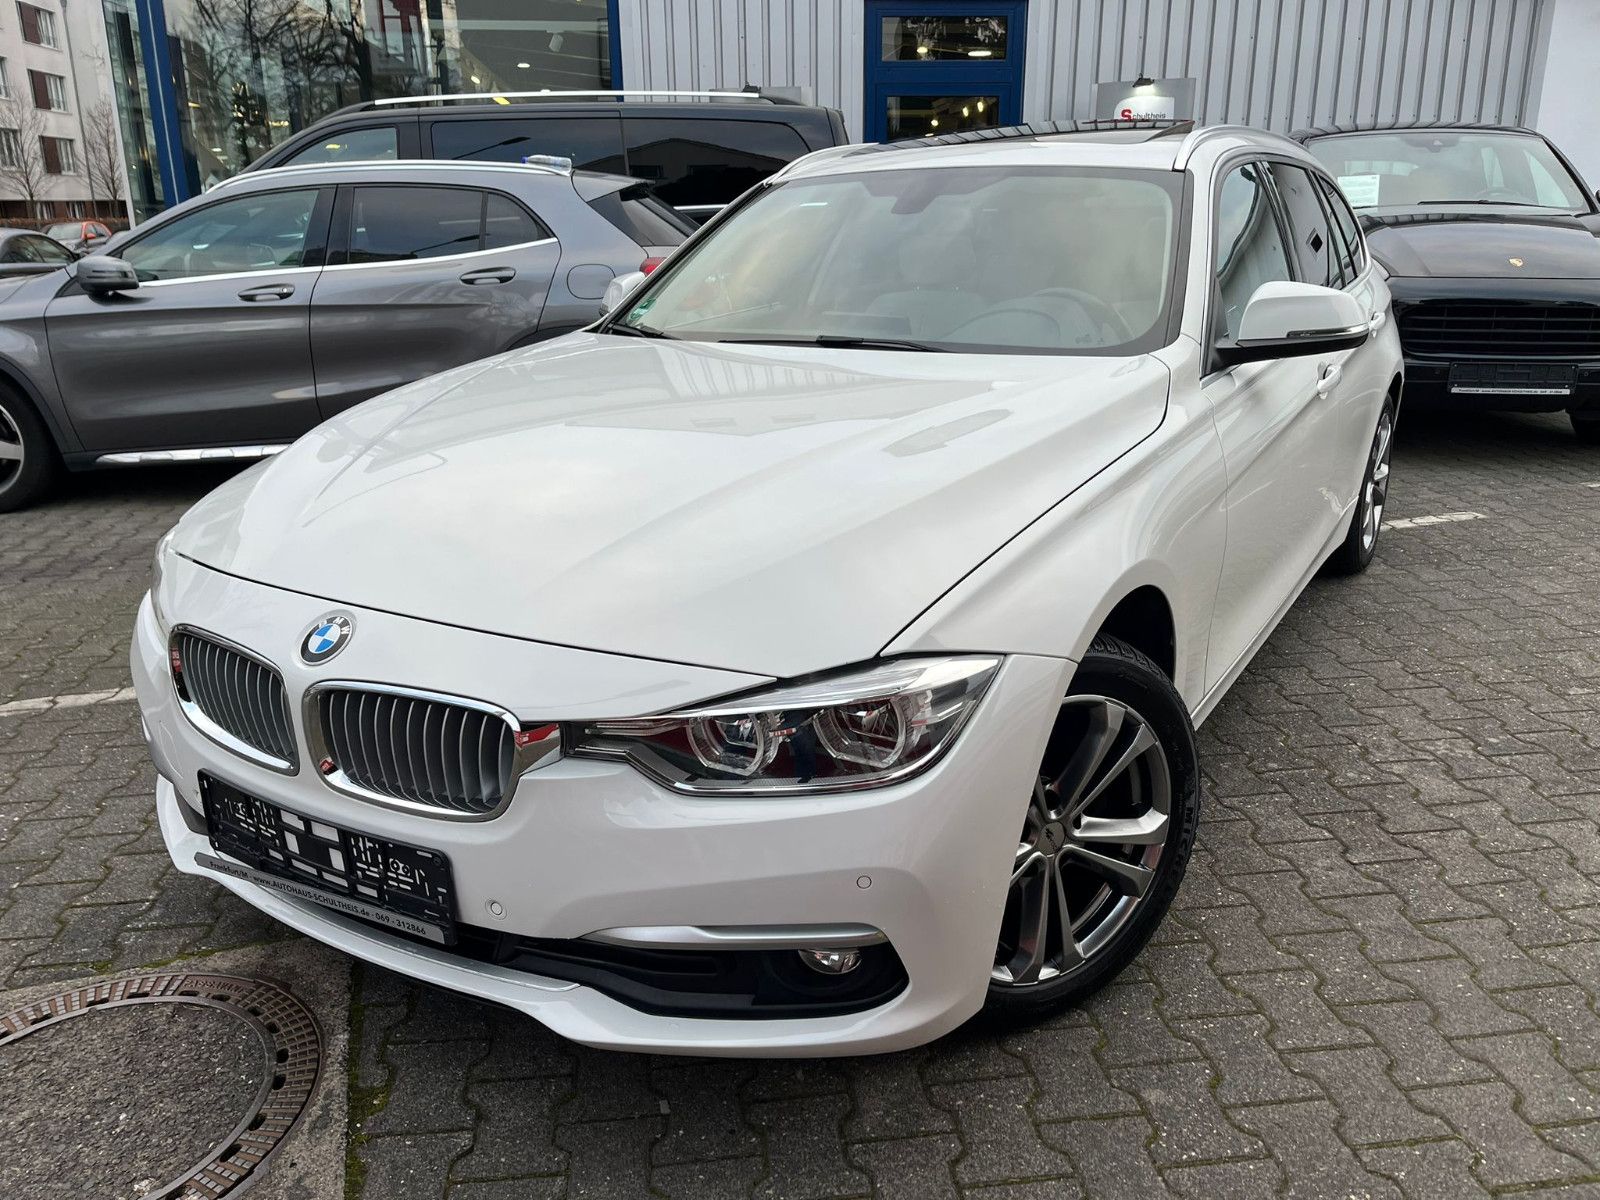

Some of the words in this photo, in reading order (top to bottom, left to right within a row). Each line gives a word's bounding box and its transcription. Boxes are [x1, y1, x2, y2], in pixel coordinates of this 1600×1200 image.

[1121, 109, 1166, 121] Schultheis
[209, 861, 248, 879] Frankfurt/M
[253, 876, 370, 916] www.AUTOHAUS-SCHULTHEIS.de
[375, 913, 390, 923] 069
[396, 919, 426, 935] 312866
